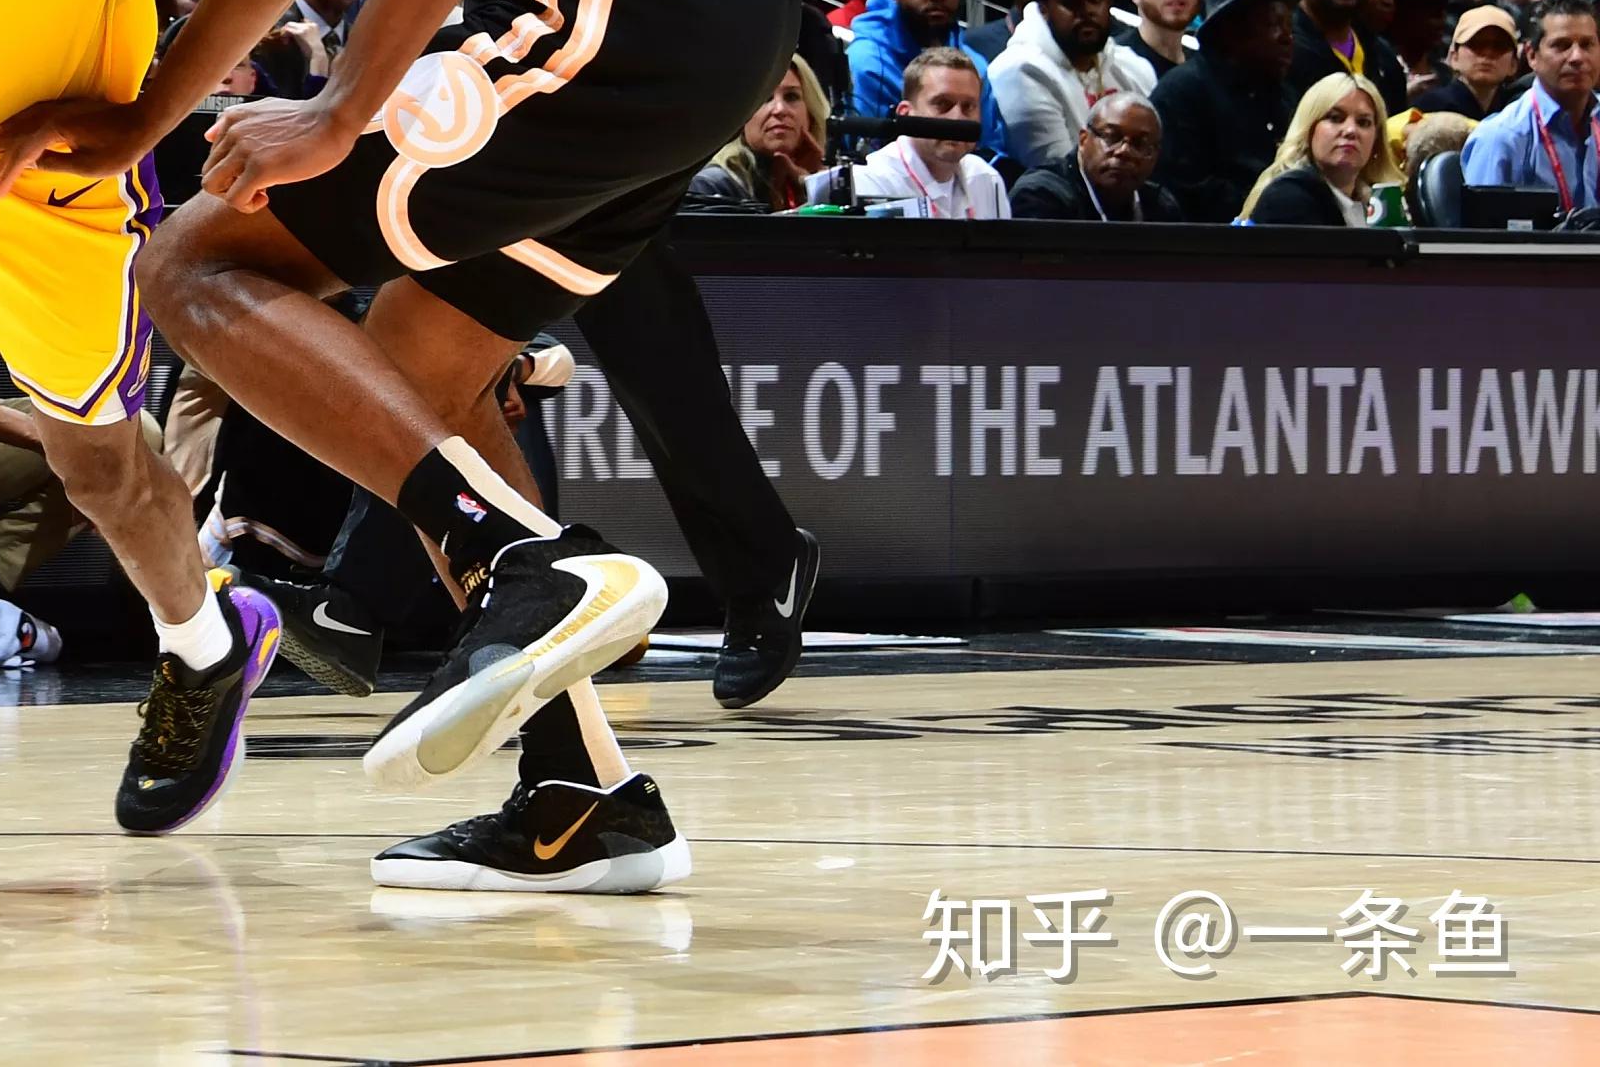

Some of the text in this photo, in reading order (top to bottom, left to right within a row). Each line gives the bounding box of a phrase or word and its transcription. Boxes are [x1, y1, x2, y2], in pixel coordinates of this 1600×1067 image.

[803, 362, 900, 480] OF
[919, 364, 1062, 477] THE
[1081, 365, 1398, 476] ATLANTA
